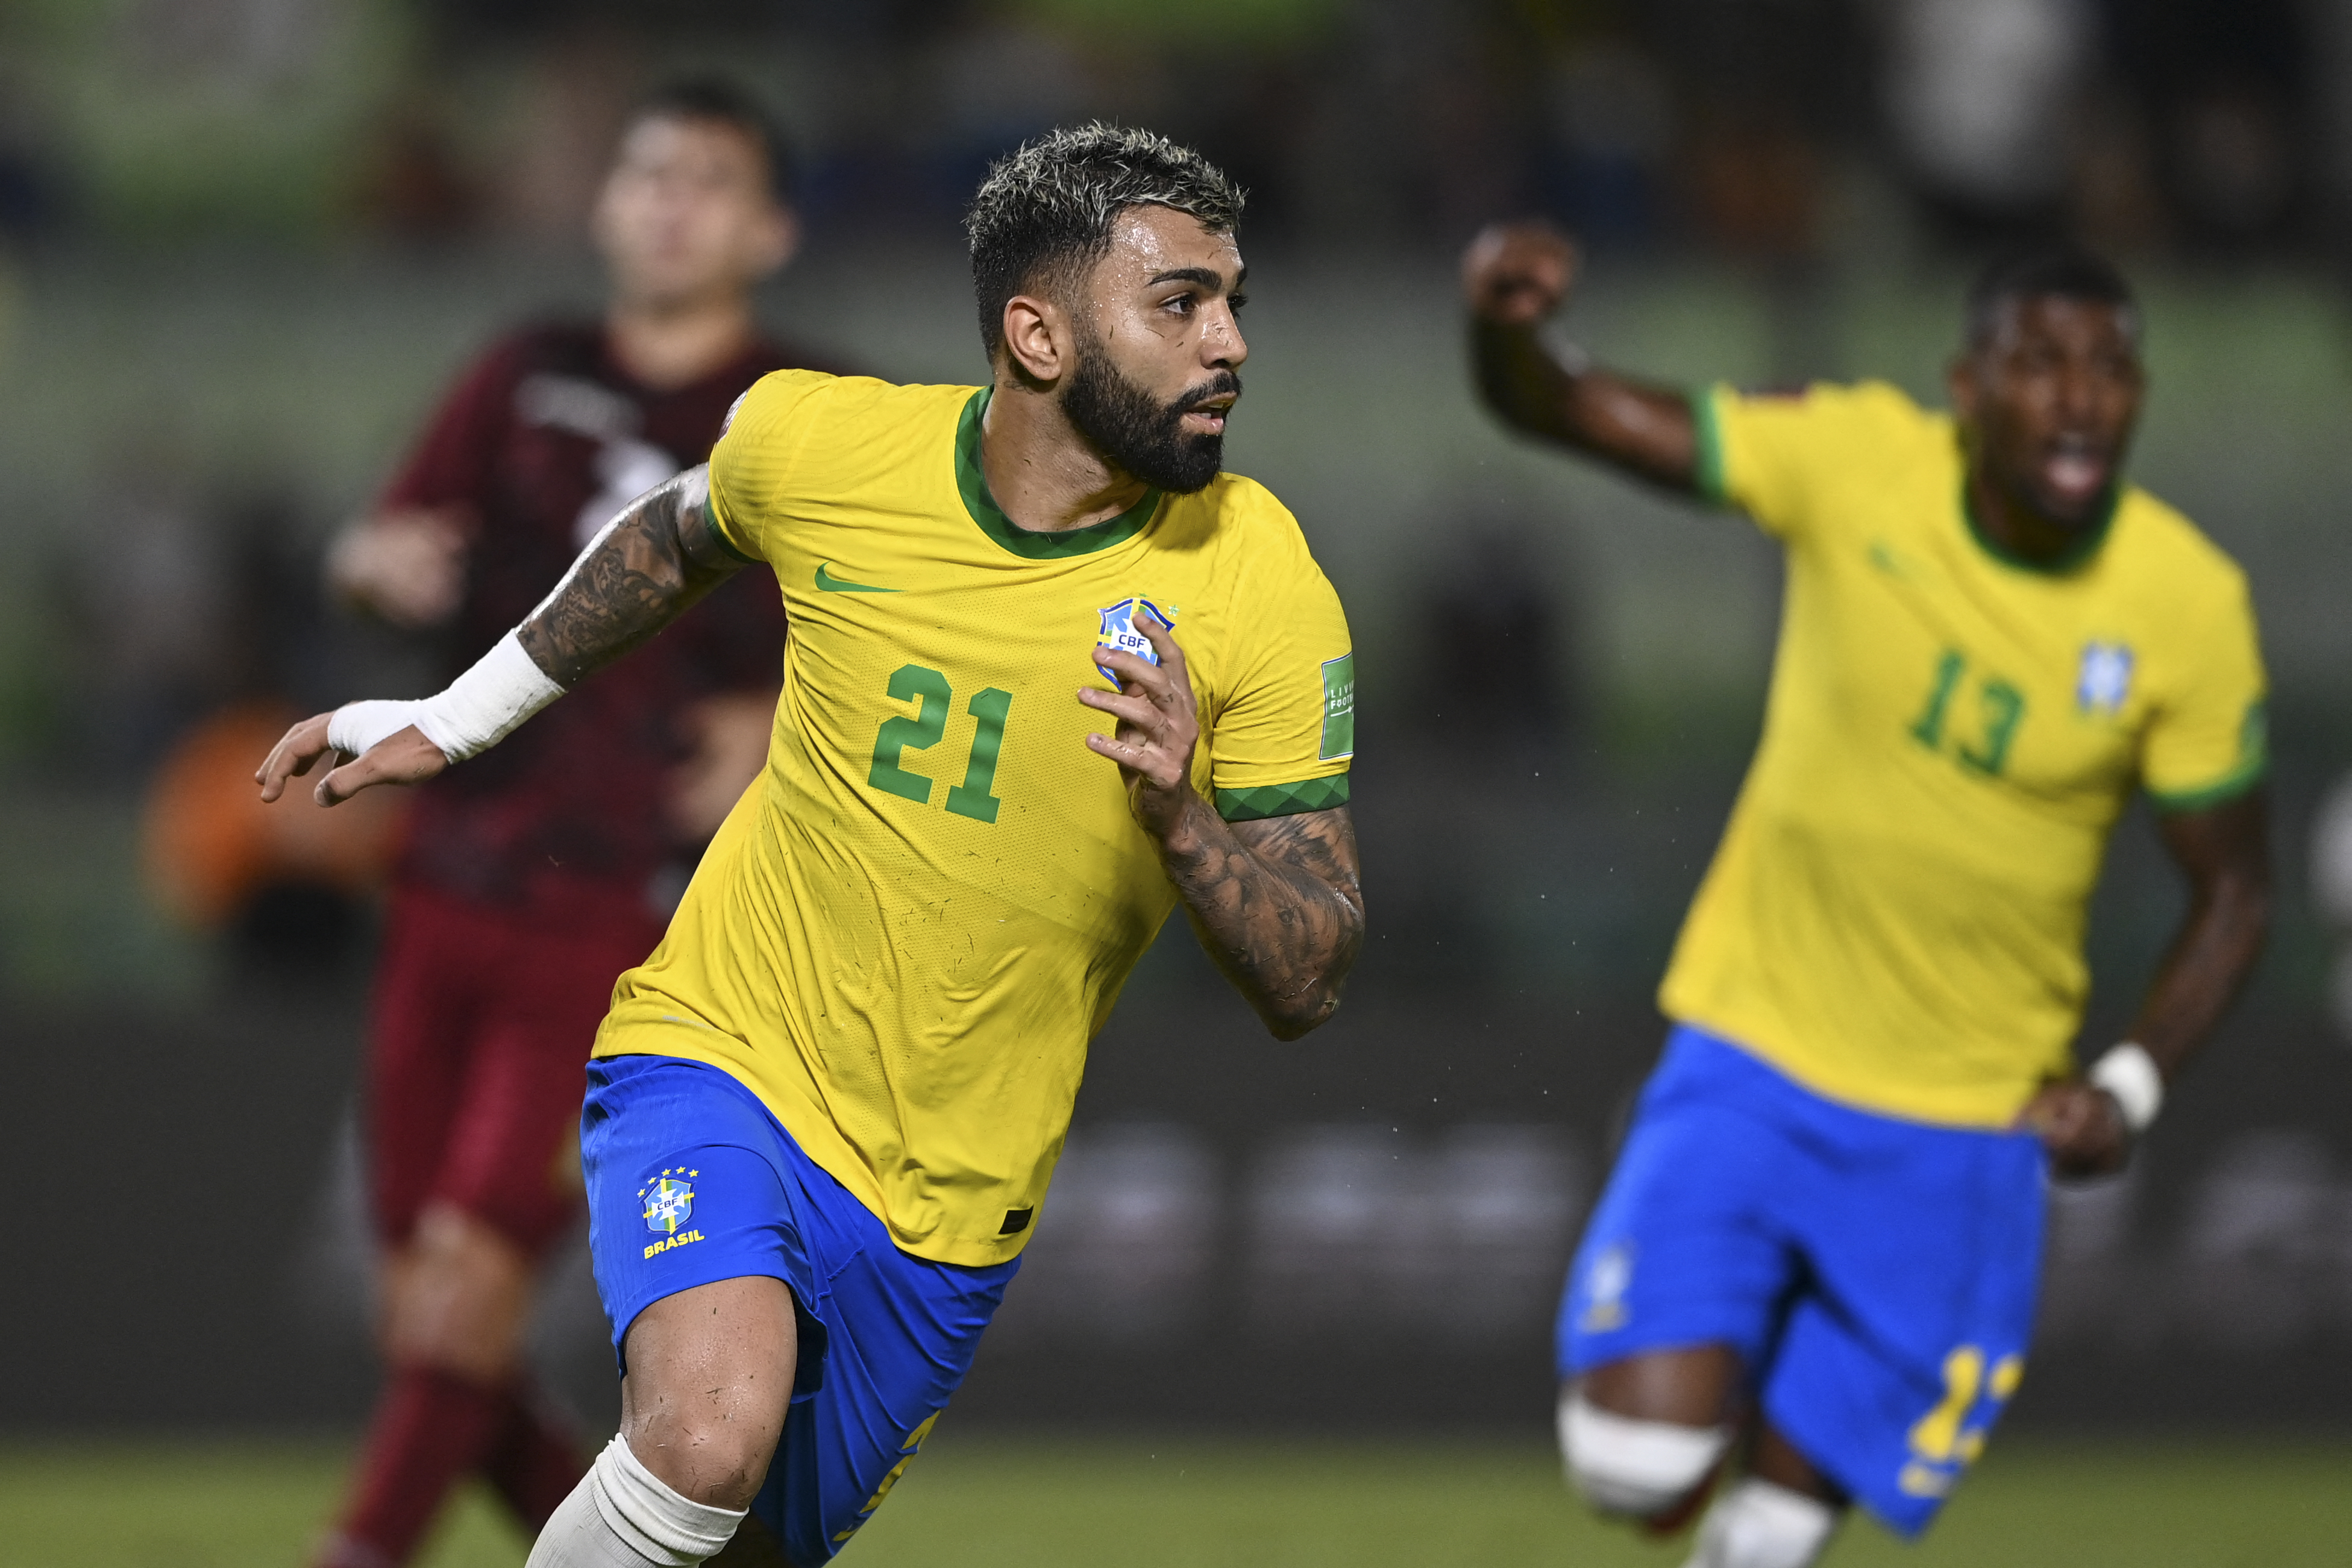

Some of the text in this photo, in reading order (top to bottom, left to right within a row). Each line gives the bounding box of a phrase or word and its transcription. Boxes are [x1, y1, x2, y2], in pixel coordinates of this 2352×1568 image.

[1118, 635, 1146, 648] CBF
[1331, 693, 1353, 710] FOOTB
[1907, 646, 2025, 777] 13
[867, 663, 1013, 824] 21
[657, 1198, 678, 1210] CBF
[644, 1229, 704, 1259] BRASIL
